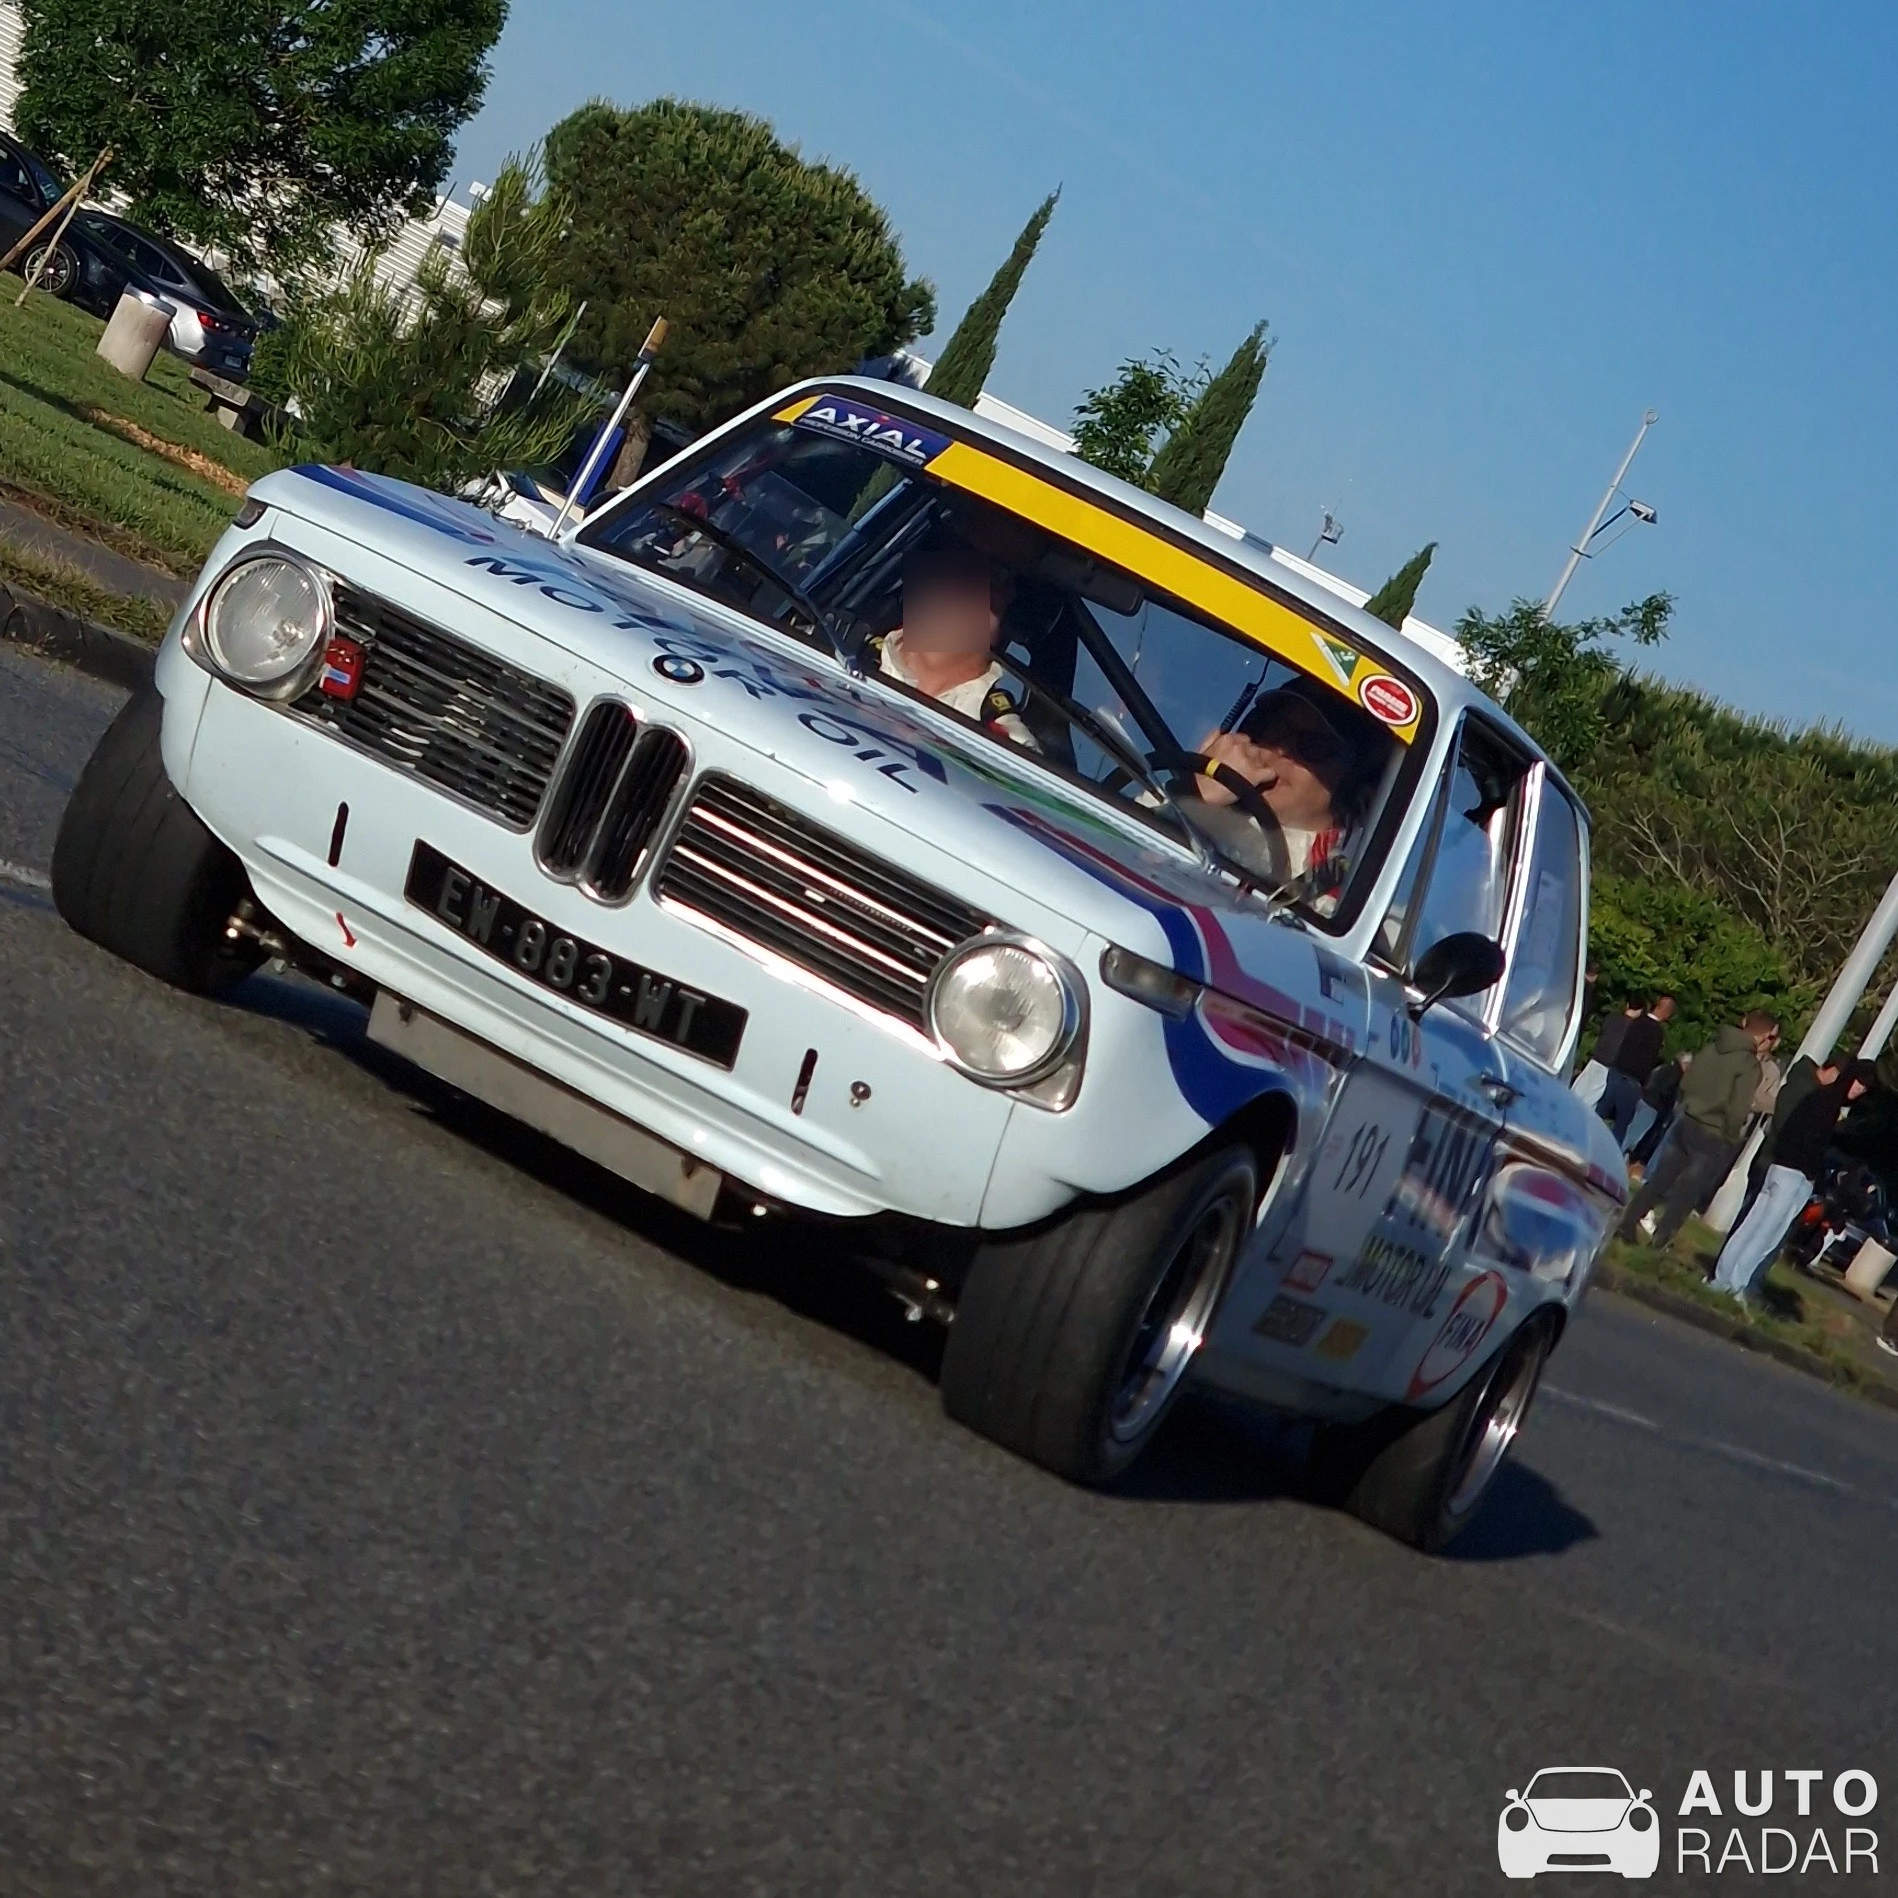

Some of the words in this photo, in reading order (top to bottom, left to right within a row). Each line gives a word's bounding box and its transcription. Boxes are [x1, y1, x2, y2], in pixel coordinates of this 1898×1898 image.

[804, 407, 927, 460] AXIAL
[462, 556, 777, 701] MOTOR
[797, 712, 919, 794] OIL
[437, 867, 707, 1043] EW-883-WT
[1333, 1122, 1391, 1199] 191
